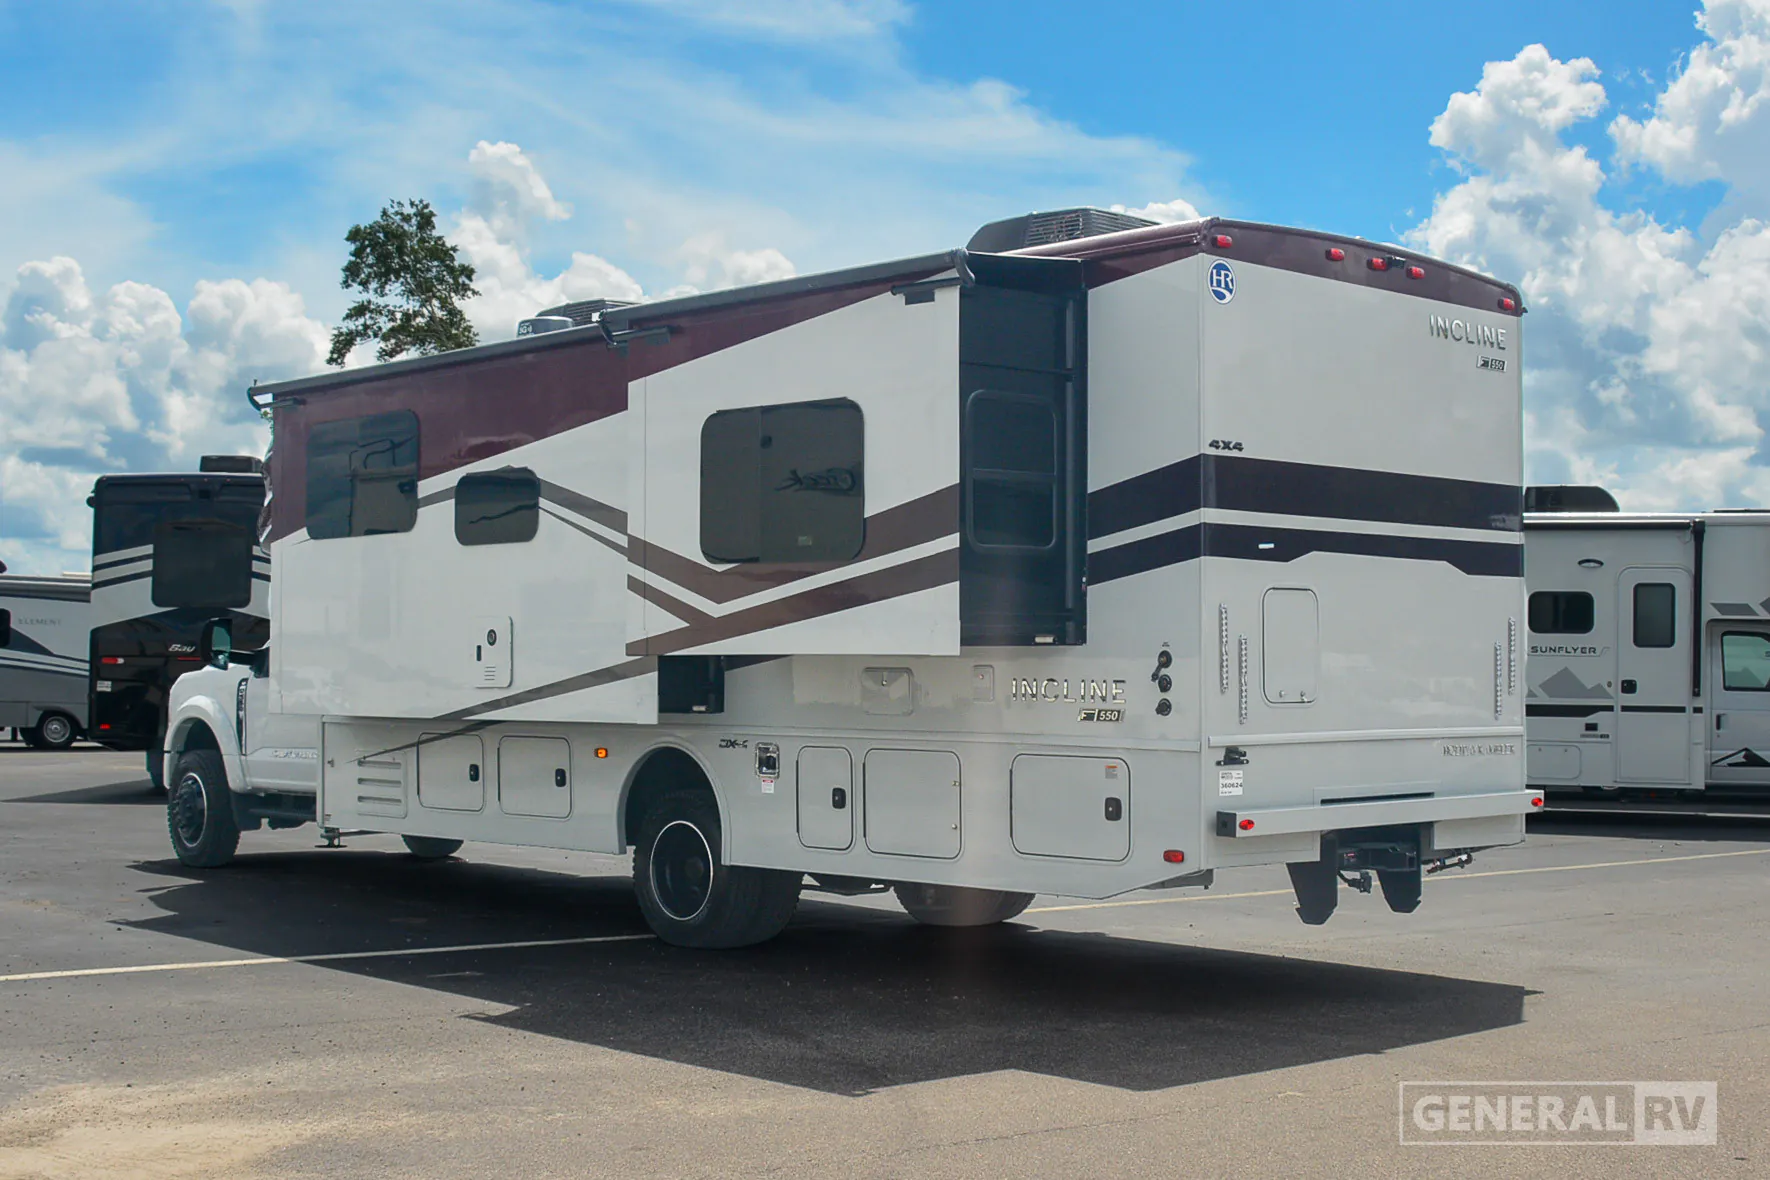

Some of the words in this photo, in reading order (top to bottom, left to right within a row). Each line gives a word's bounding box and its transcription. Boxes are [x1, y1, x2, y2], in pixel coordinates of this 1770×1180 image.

[1212, 269, 1234, 289] HR
[1429, 313, 1506, 350] INCLINE
[18, 618, 61, 626] ELEMENT
[1530, 645, 1597, 655] SUNFLYER
[1011, 677, 1127, 704] INCLINE
[1099, 710, 1119, 721] 550
